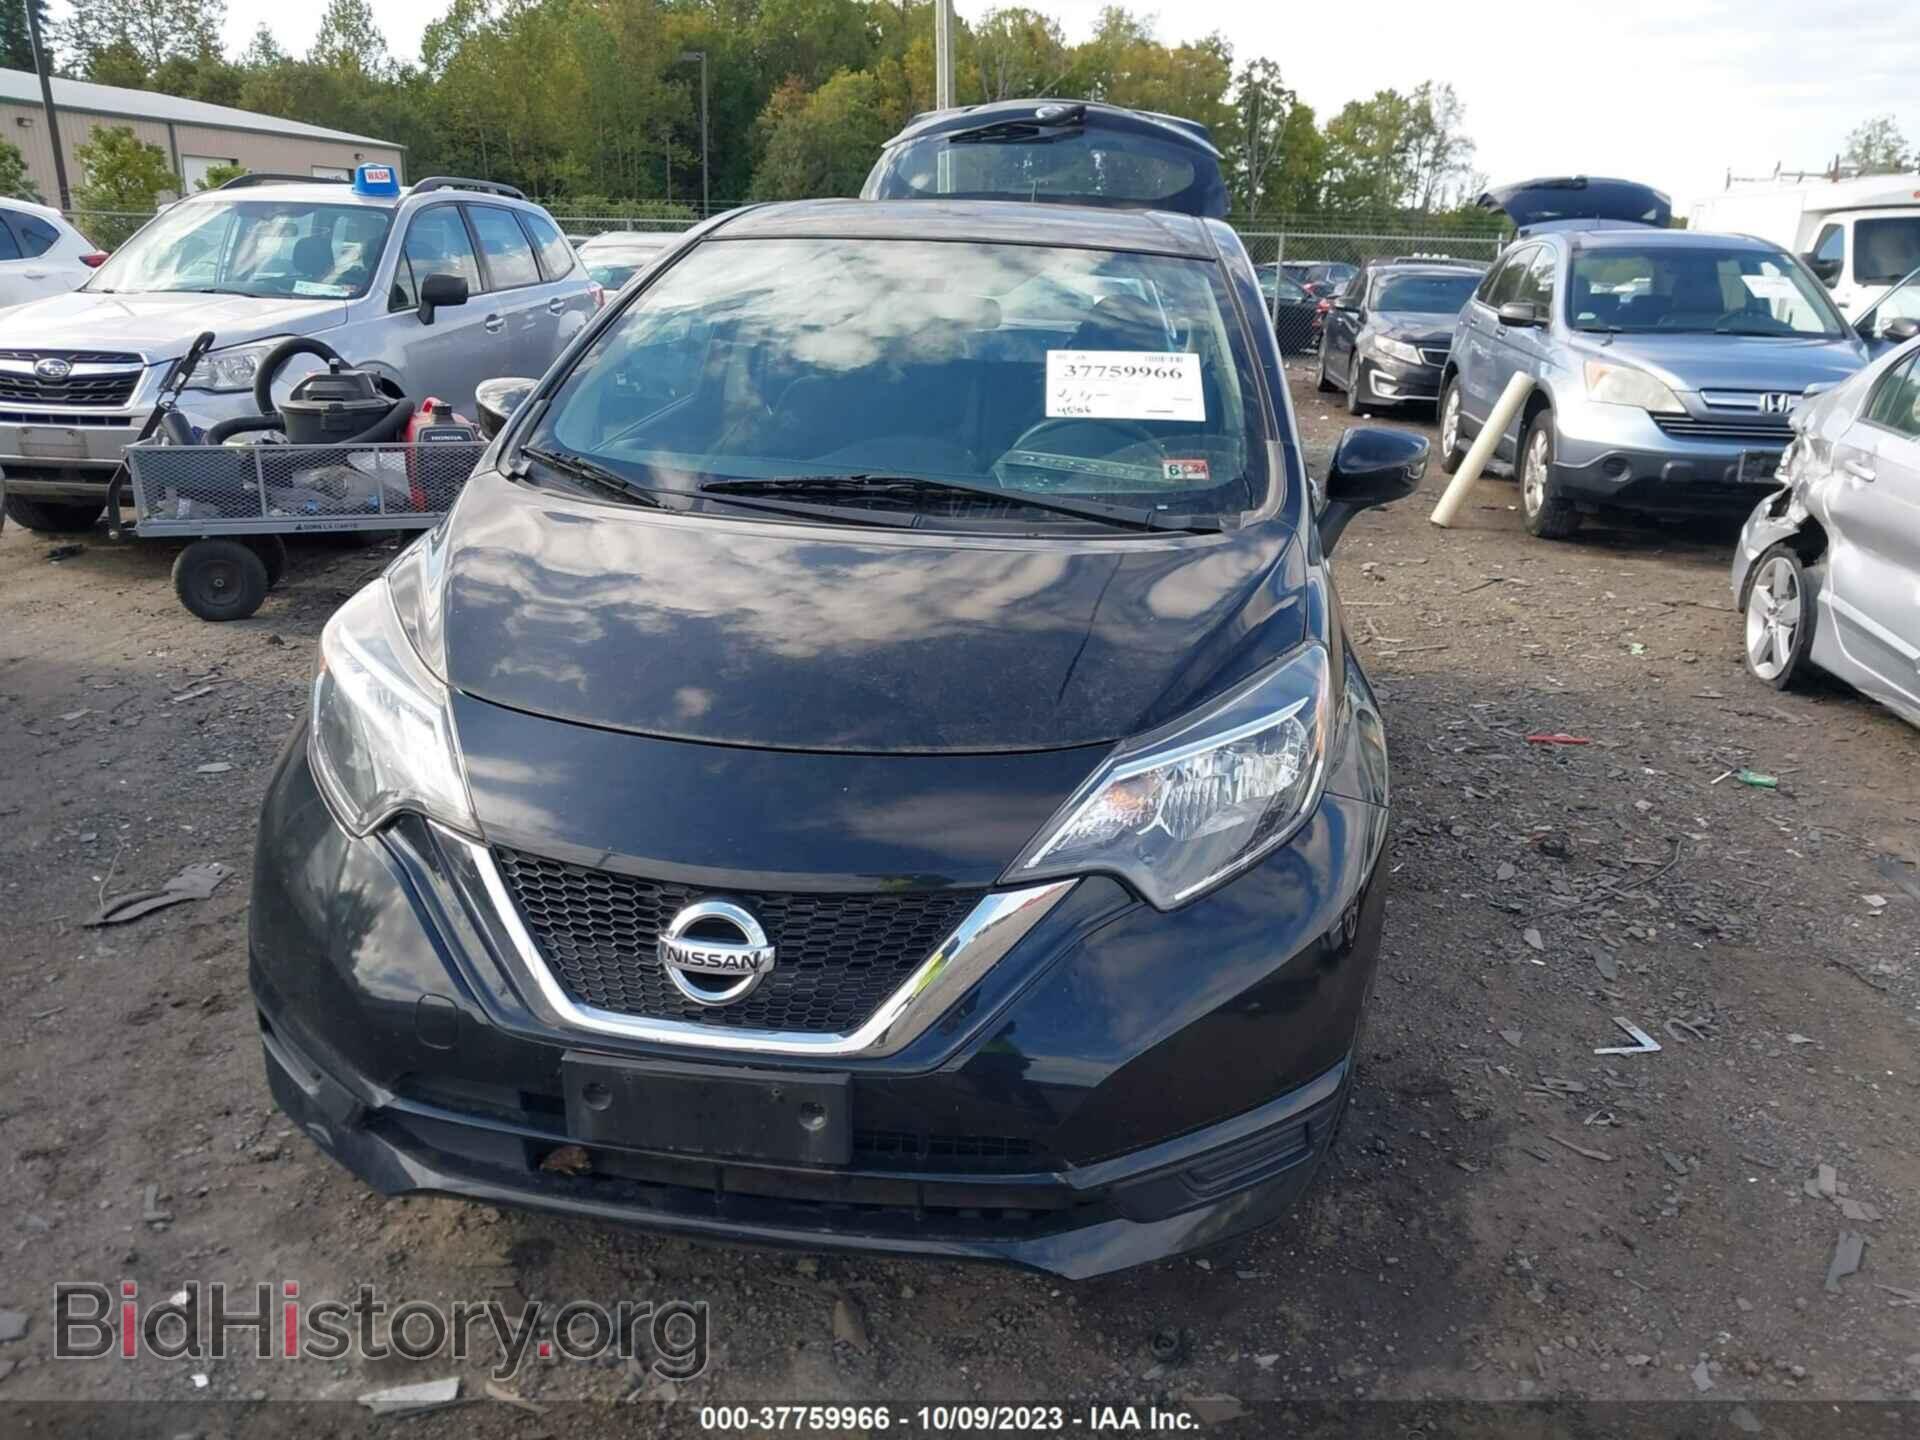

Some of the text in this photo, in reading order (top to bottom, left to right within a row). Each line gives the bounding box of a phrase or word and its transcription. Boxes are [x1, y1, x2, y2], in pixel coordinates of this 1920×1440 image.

[367, 170, 389, 180] WASH
[1064, 364, 1184, 380] 37759966
[1168, 463, 1181, 476] 6
[667, 946, 760, 970] NISSAN
